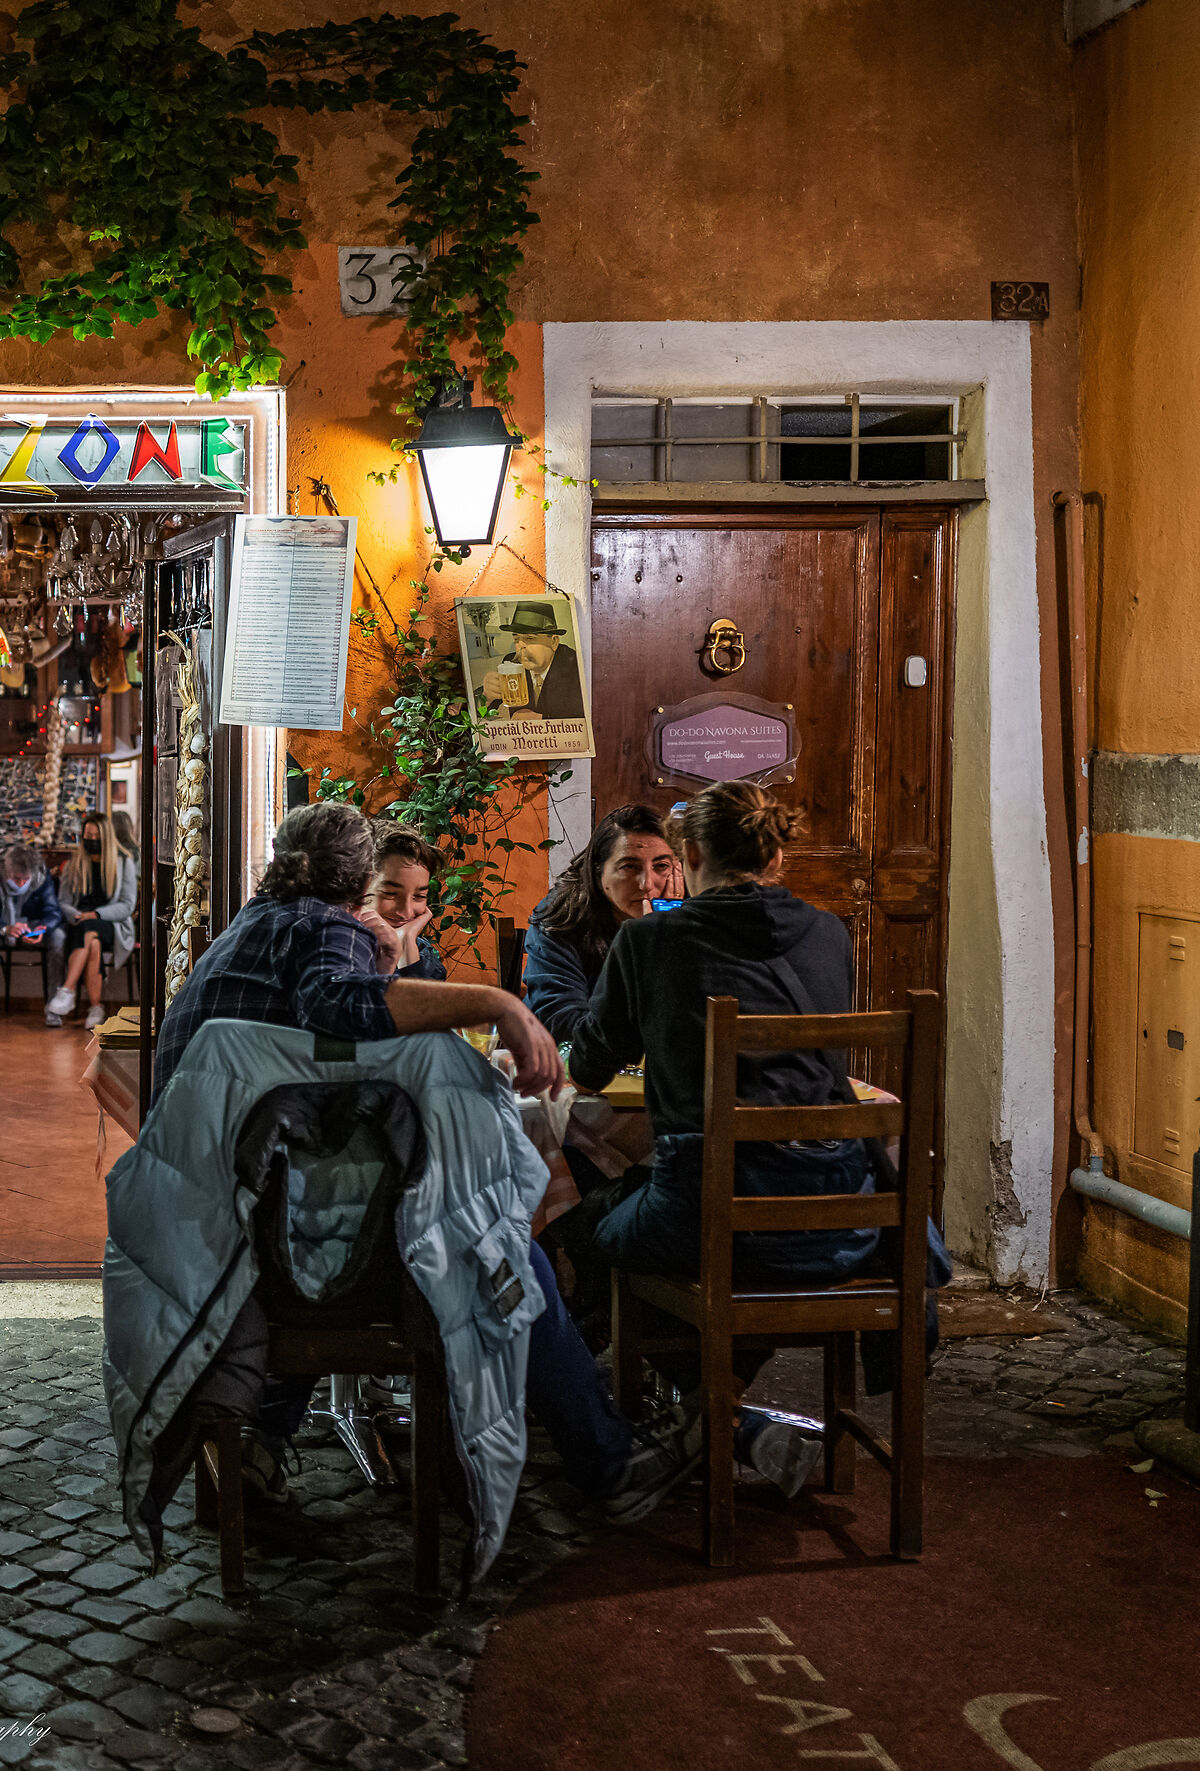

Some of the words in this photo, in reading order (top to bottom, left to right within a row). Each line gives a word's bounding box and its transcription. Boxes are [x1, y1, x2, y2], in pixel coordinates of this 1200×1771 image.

[344, 252, 418, 305] 32
[522, 720, 544, 736] Bire
[543, 720, 584, 735] Furlane
[668, 728, 704, 737] DO-DO
[705, 726, 748, 738] NAVONA
[750, 725, 782, 736] SUITES
[511, 735, 558, 750] Moretti
[564, 740, 581, 748] 1859
[704, 750, 723, 763] Guest
[722, 750, 745, 759] House
